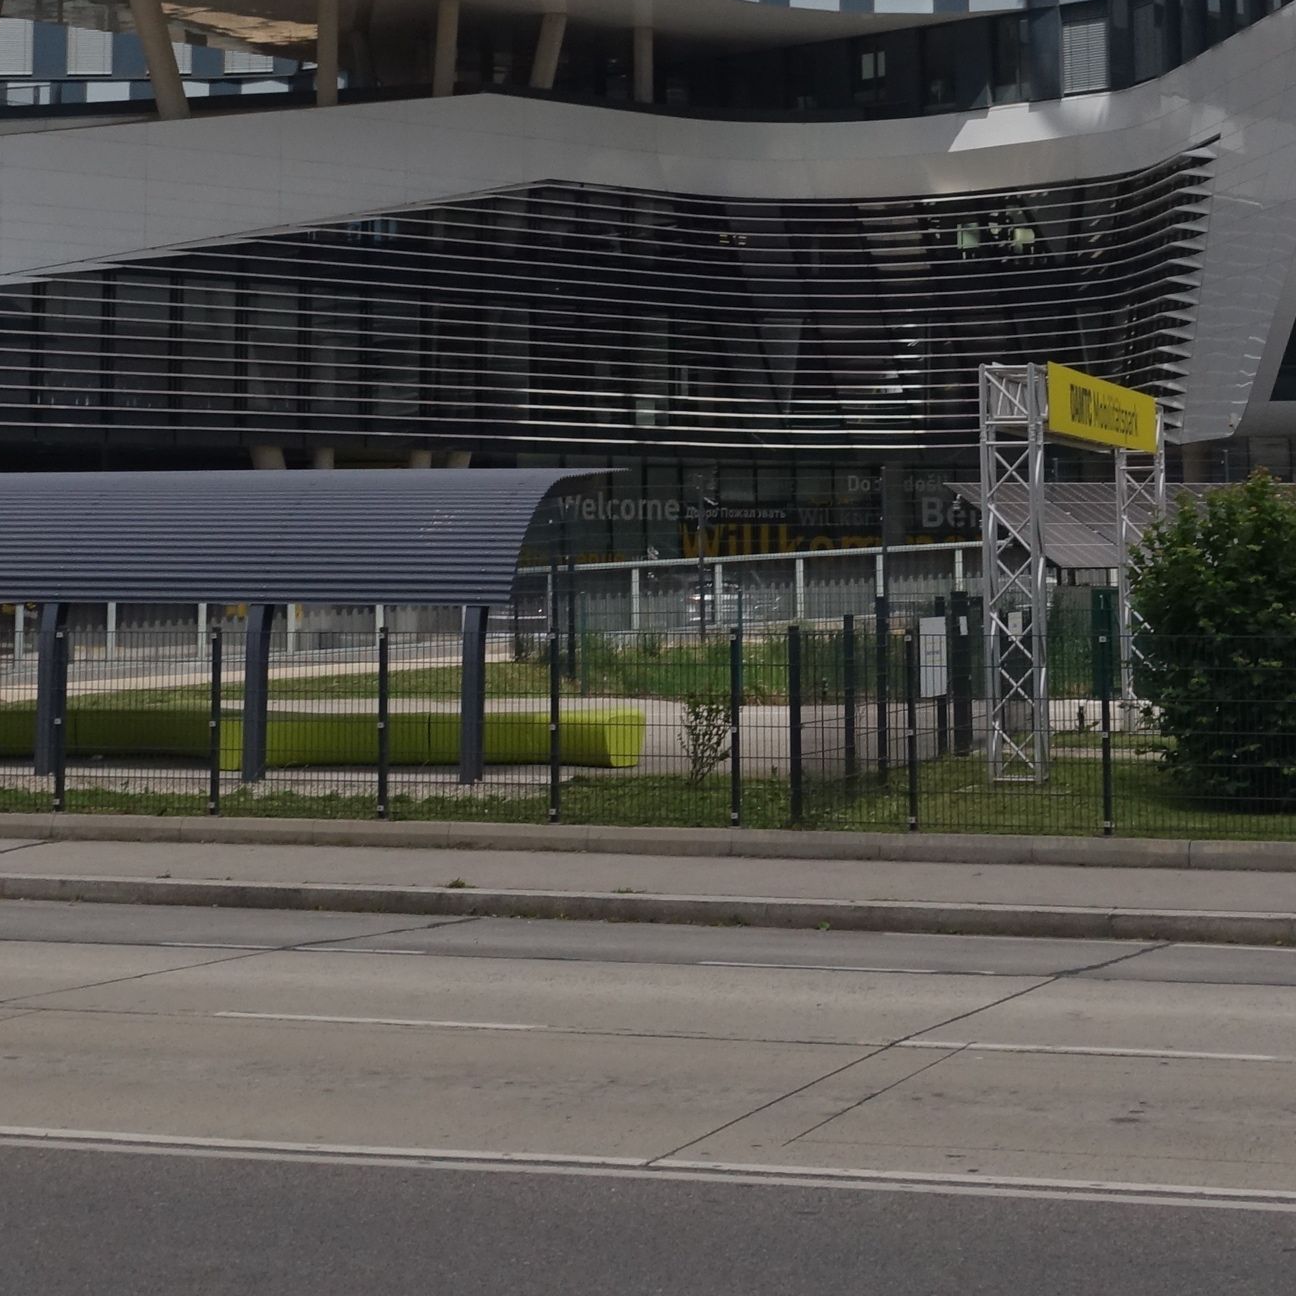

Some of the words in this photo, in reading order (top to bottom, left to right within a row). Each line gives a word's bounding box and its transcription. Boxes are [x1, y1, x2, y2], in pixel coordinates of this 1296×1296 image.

[1070, 384, 1092, 427] ÖAMTC
[559, 492, 680, 521] Welcome
[686, 506, 717, 519] Доро
